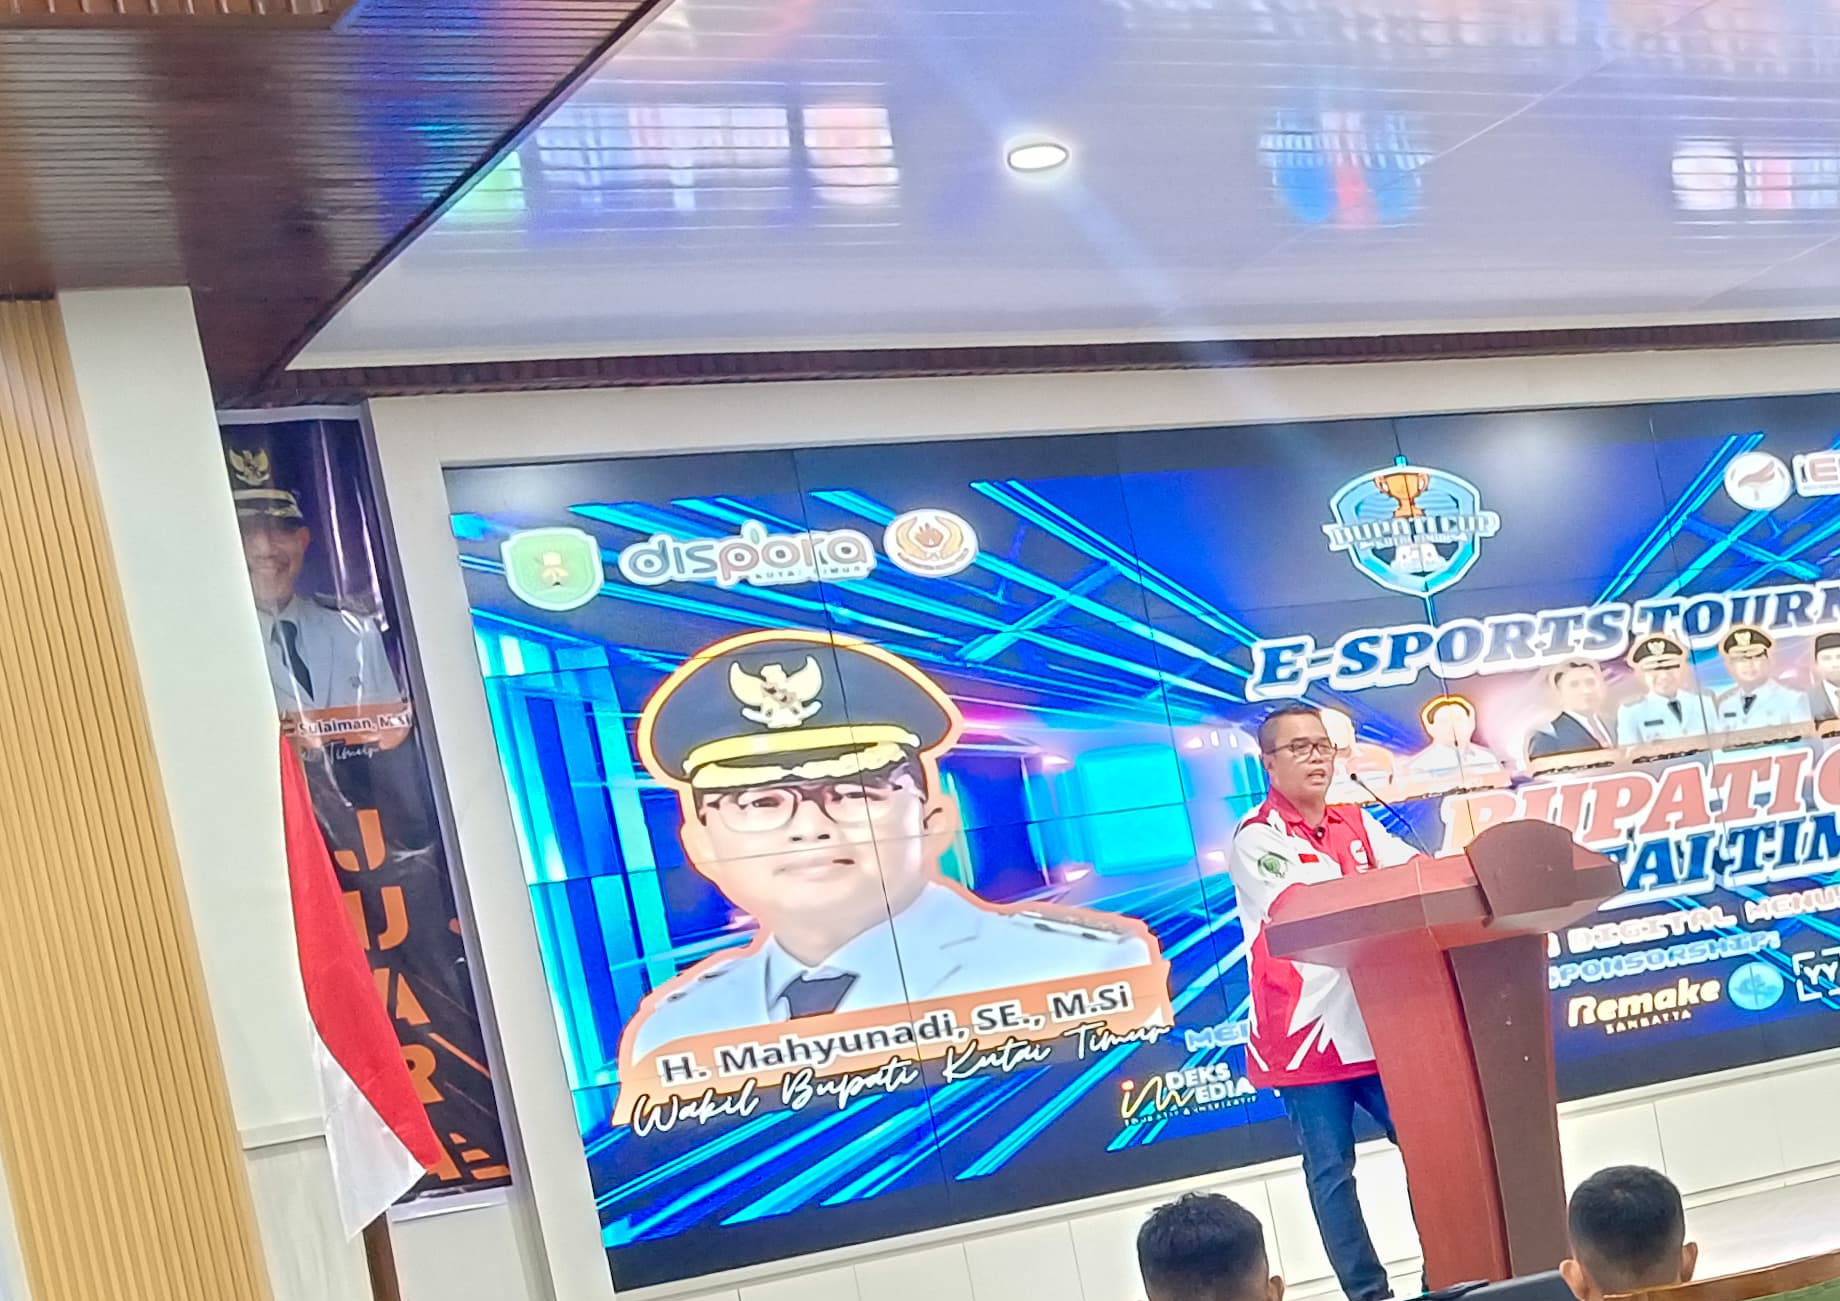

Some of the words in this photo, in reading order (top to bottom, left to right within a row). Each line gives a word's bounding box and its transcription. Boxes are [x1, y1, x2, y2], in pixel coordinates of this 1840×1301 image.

[628, 529, 868, 582] dispora
[1250, 605, 1630, 688] E-SPORTS
[1567, 906, 1737, 954] DIGITAL
[662, 1055, 708, 1084] H.
[720, 1010, 968, 1075] Mahyunadi,
[1053, 984, 1129, 1020] M.Si
[1567, 977, 1721, 1027] Remake
[632, 1078, 760, 1138] Wakil
[781, 1056, 920, 1111] Bupati
[942, 1032, 1051, 1080] Kutai
[1062, 1021, 1172, 1060] Timur
